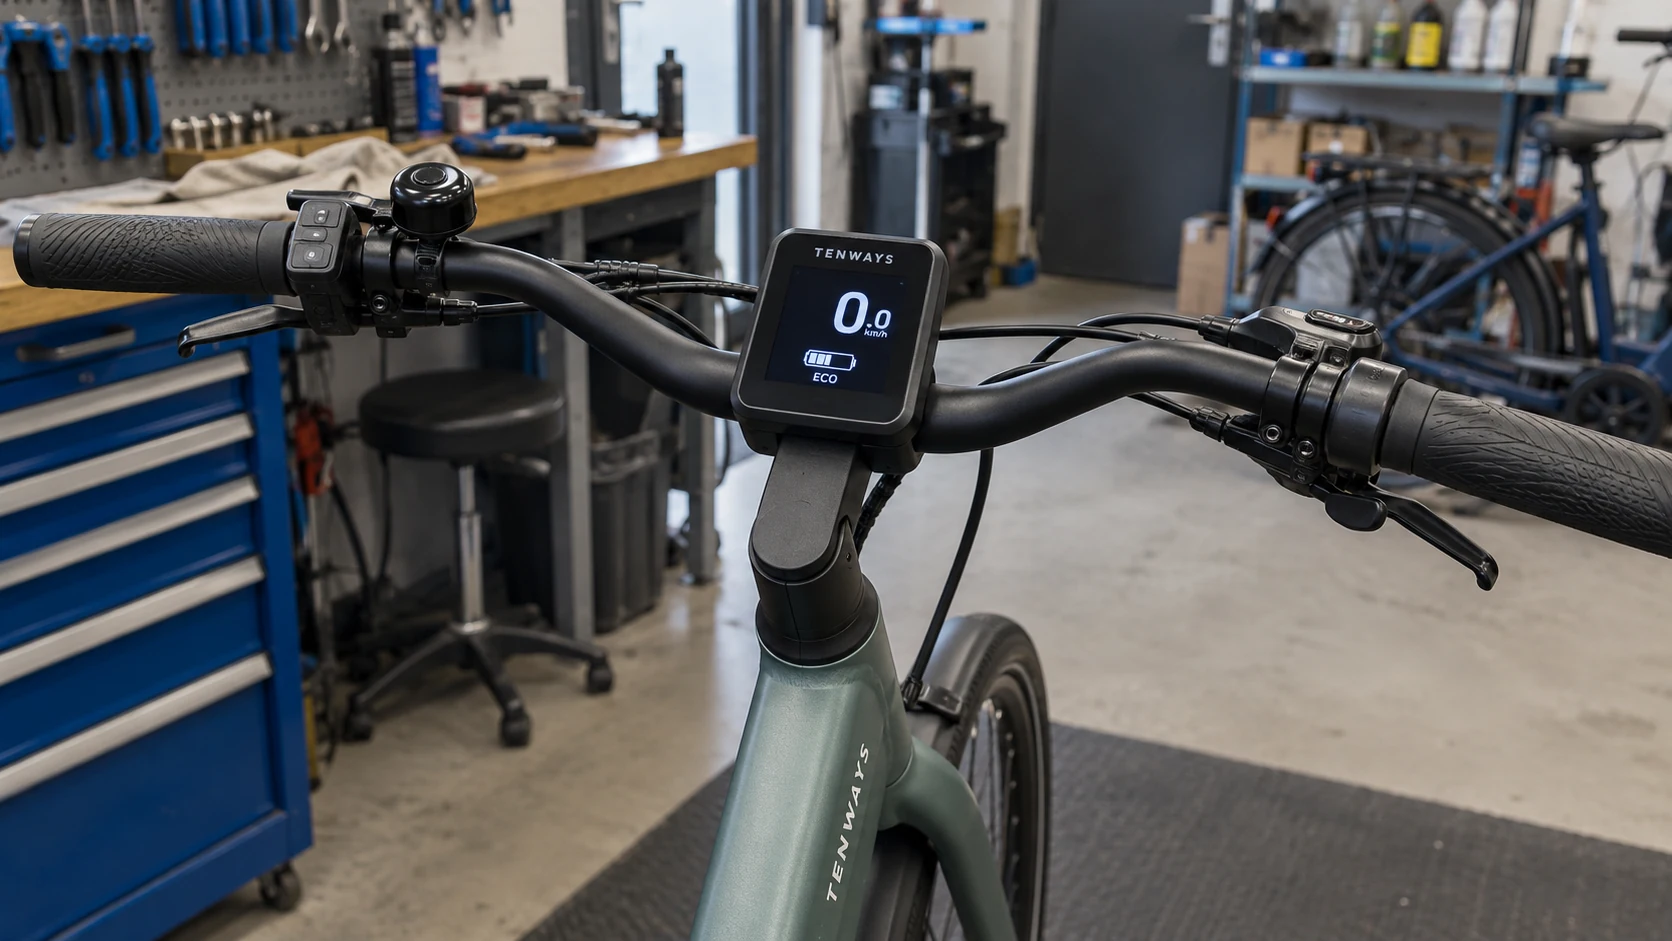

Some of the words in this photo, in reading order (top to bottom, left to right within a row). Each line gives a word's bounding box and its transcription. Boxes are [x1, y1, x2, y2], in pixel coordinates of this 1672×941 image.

[814, 247, 894, 265] TENWAYS
[833, 291, 892, 334] 0.0
[863, 328, 888, 338] km/h
[812, 372, 838, 384] ECO
[826, 743, 869, 902] TENWAYS
